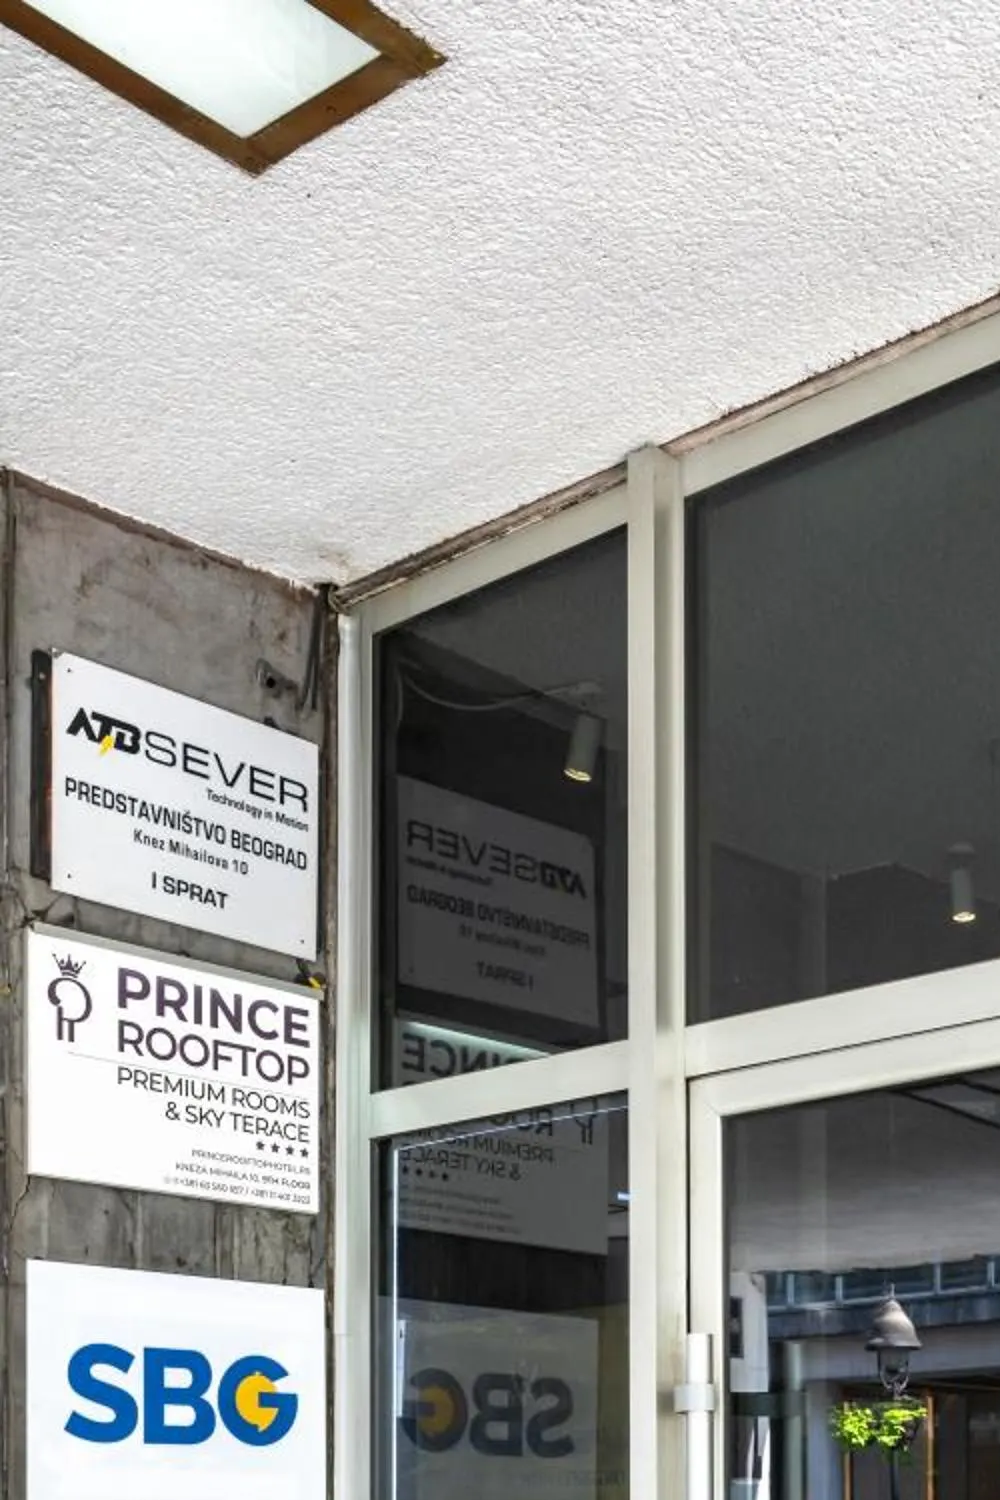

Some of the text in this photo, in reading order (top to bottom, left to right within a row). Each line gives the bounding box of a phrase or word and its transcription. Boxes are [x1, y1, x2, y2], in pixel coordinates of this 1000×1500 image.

[65, 776, 308, 871] PREDSTAVNIŠTVO BEOGRAD
[206, 787, 263, 821] Technology
[264, 804, 273, 820] in
[133, 828, 249, 875] Knez Mihailova 10
[151, 871, 229, 910] I SPRAT
[117, 967, 310, 1048] PRINCE
[117, 1019, 310, 1086] ROOFTOP
[117, 1066, 311, 1119] PREMIUM ROOMS
[165, 1101, 310, 1144] & SKY TERACE
[64, 1343, 298, 1446] SBG
